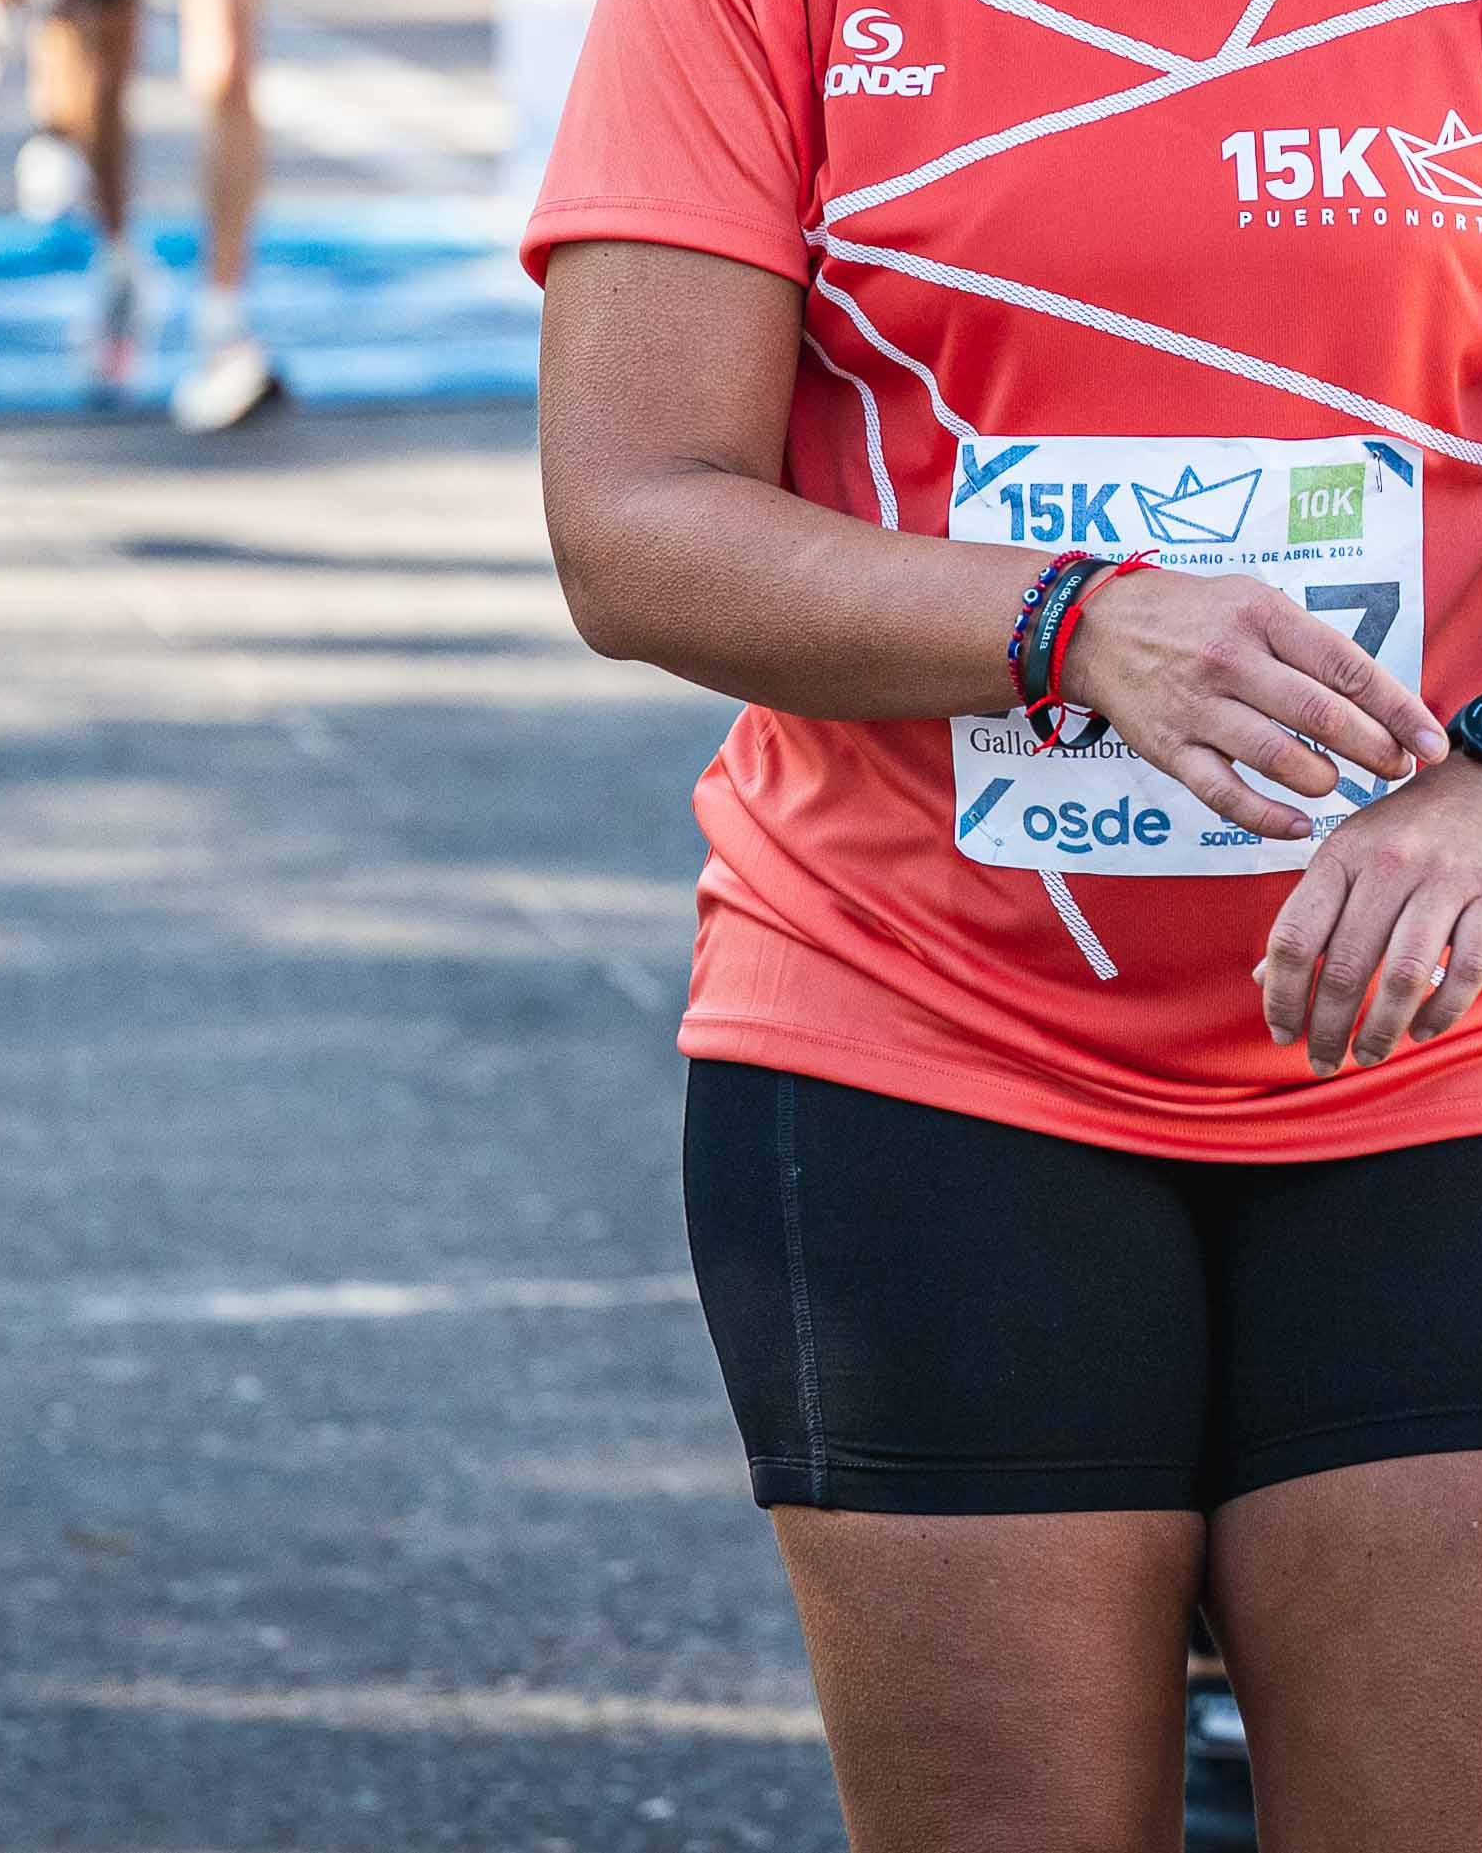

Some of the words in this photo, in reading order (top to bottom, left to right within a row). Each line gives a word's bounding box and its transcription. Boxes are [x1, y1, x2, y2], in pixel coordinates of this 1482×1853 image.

[1220, 126, 1388, 202] 15K
[1238, 207, 1389, 229] PUERTO
[999, 483, 1121, 543] 15K
[1297, 486, 1356, 520] 10K
[1159, 552, 1224, 565] ROSARIO
[1241, 553, 1257, 564] 12
[1261, 551, 1279, 563] DE
[1283, 547, 1323, 562] ABRIL
[1329, 545, 1364, 558] 2026
[969, 727, 1037, 758] Gallo
[1022, 795, 1172, 855] osde
